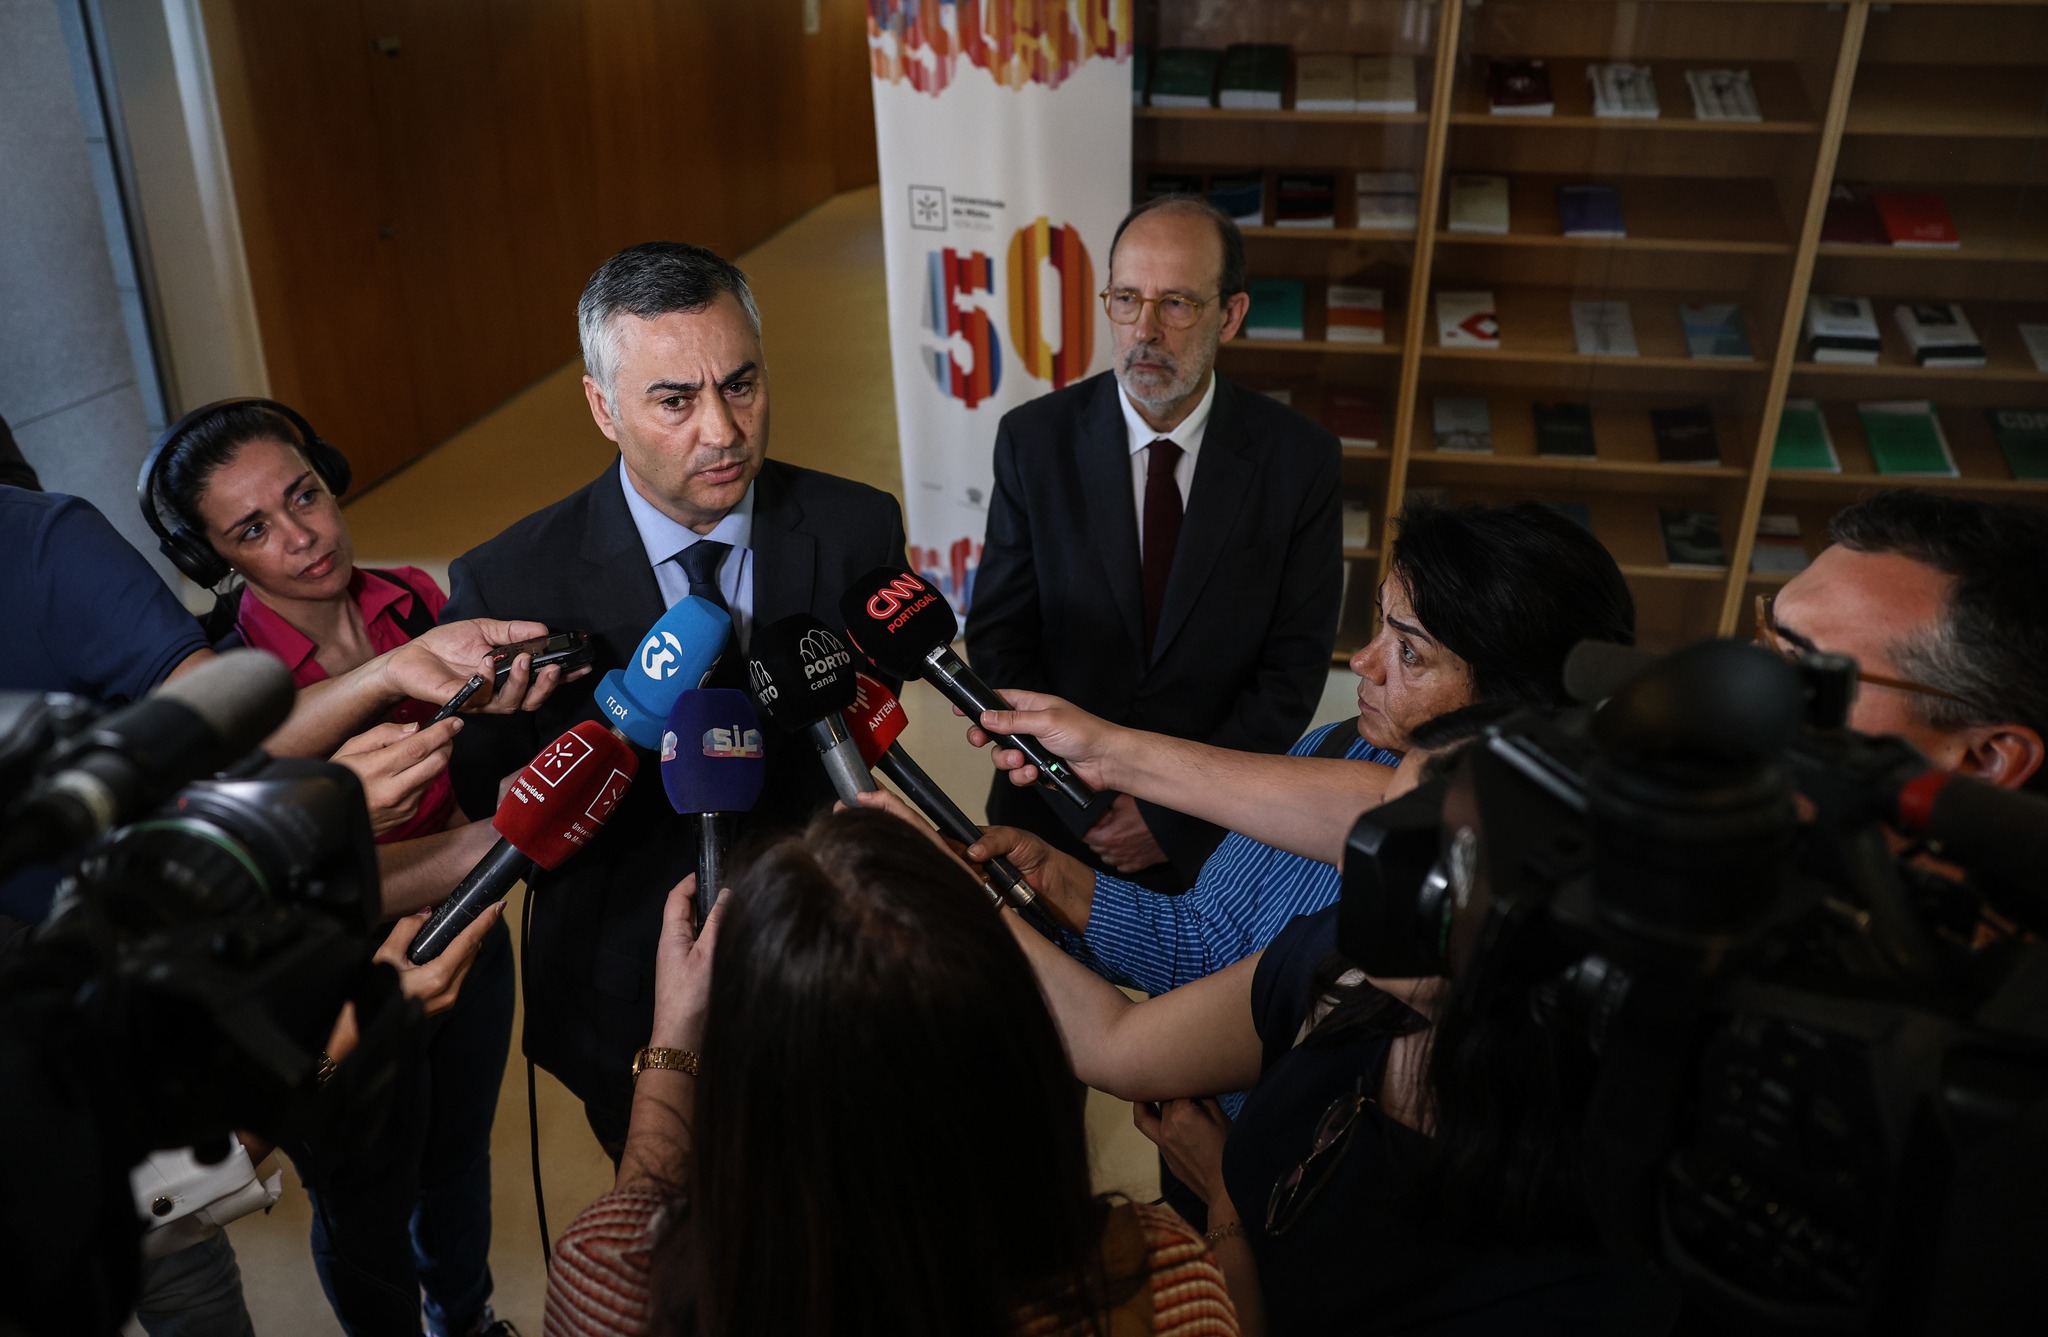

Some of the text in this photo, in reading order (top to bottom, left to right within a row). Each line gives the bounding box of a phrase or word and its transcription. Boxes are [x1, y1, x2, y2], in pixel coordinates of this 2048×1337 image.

[921, 216, 1095, 409] 50
[866, 572, 926, 620] CNN
[887, 593, 938, 634] PORTUGAL
[804, 650, 851, 680] PORTO
[810, 672, 838, 691] canal
[606, 695, 628, 720] rr.pt
[868, 697, 898, 732] ANTENA
